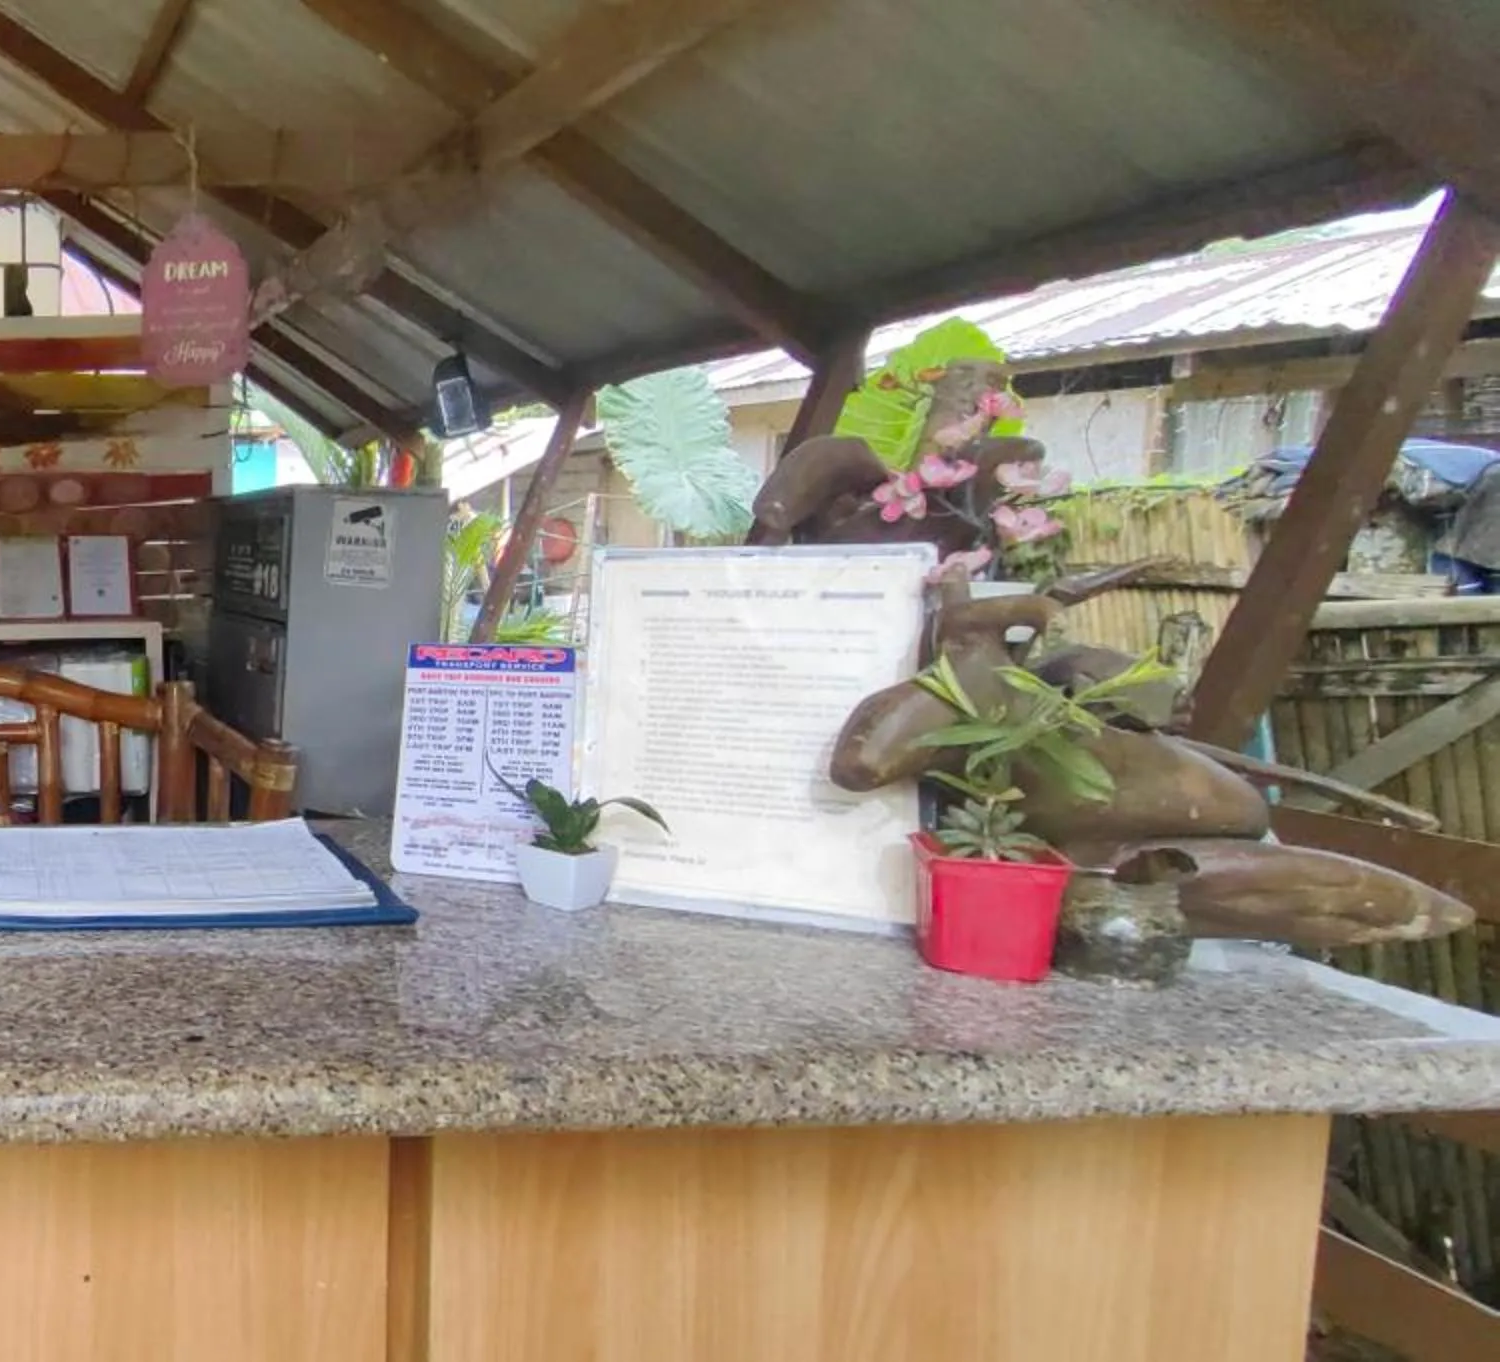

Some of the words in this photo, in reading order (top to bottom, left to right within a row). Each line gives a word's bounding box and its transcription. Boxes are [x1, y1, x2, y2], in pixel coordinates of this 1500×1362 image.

[164, 260, 229, 282] DREAM
[435, 661, 498, 669] TRANSPORT
[500, 662, 546, 671] SERVICE
